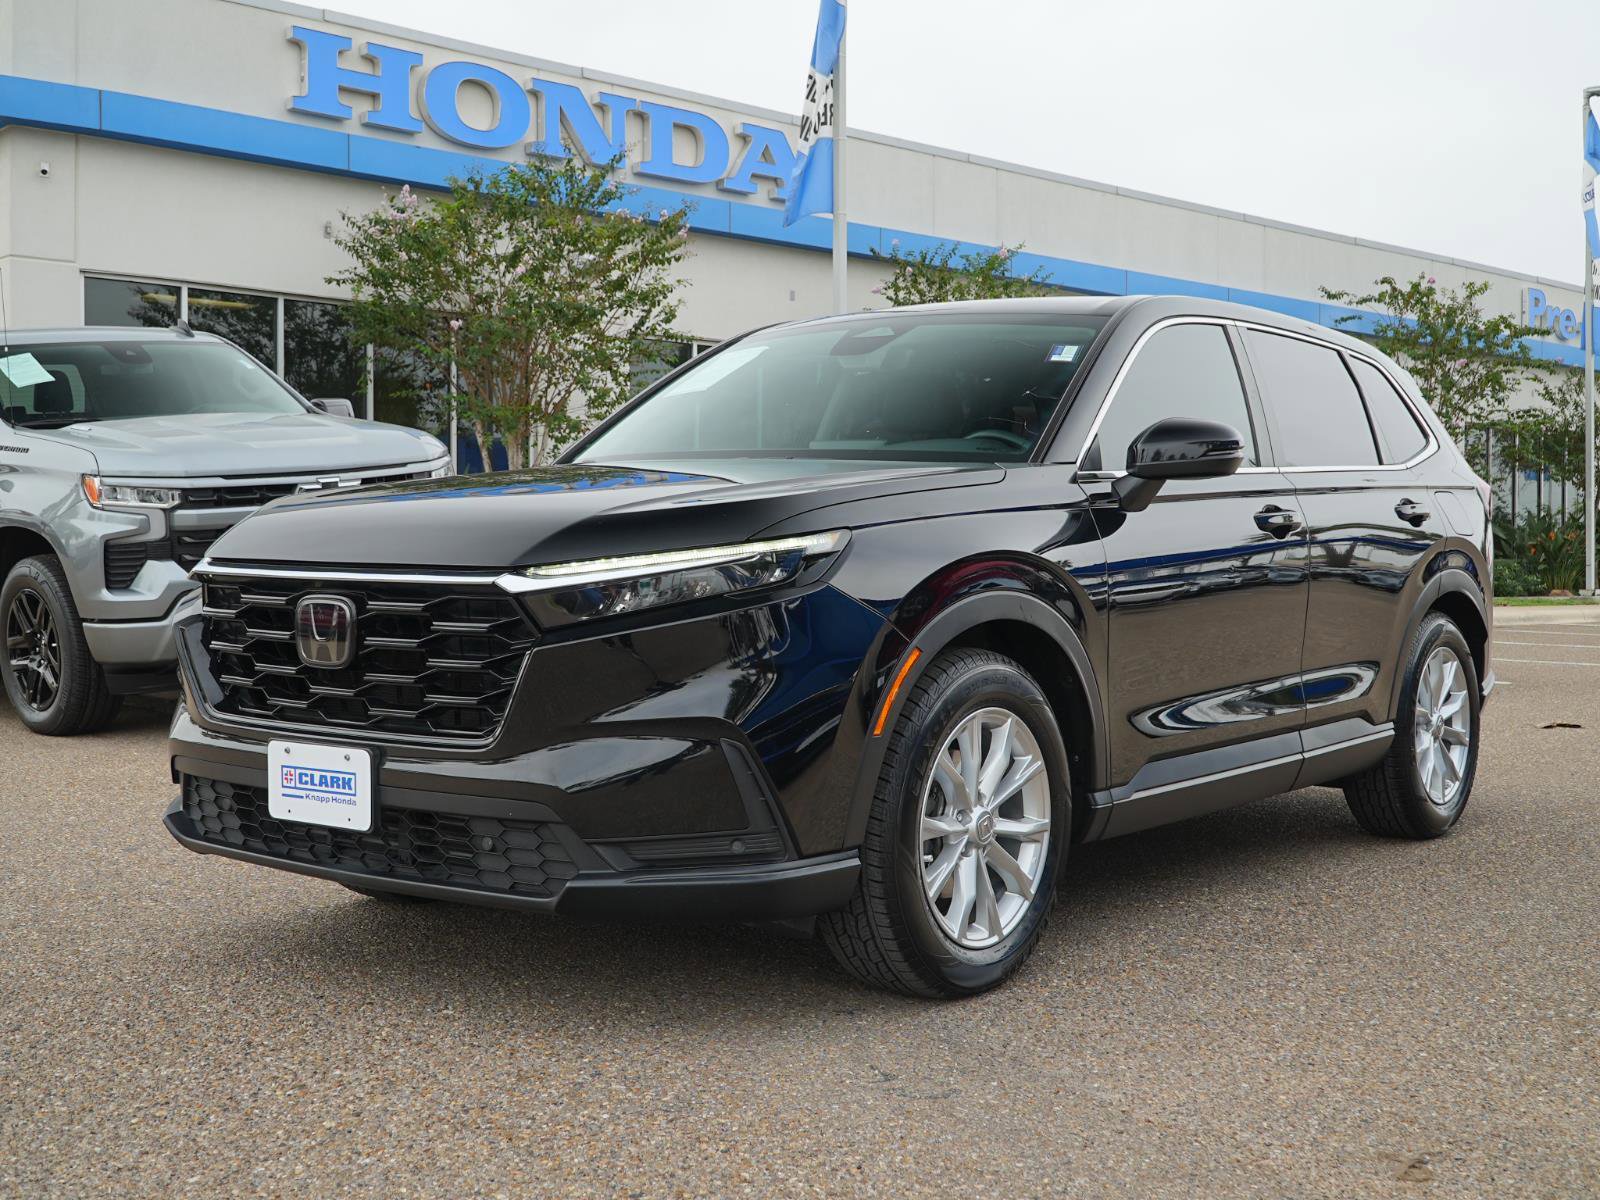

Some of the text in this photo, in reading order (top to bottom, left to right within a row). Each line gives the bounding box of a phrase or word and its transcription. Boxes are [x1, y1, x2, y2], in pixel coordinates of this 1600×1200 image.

[288, 25, 796, 202] HONDA
[298, 772, 353, 790] CLARK
[305, 793, 357, 806] Knapp Honda
